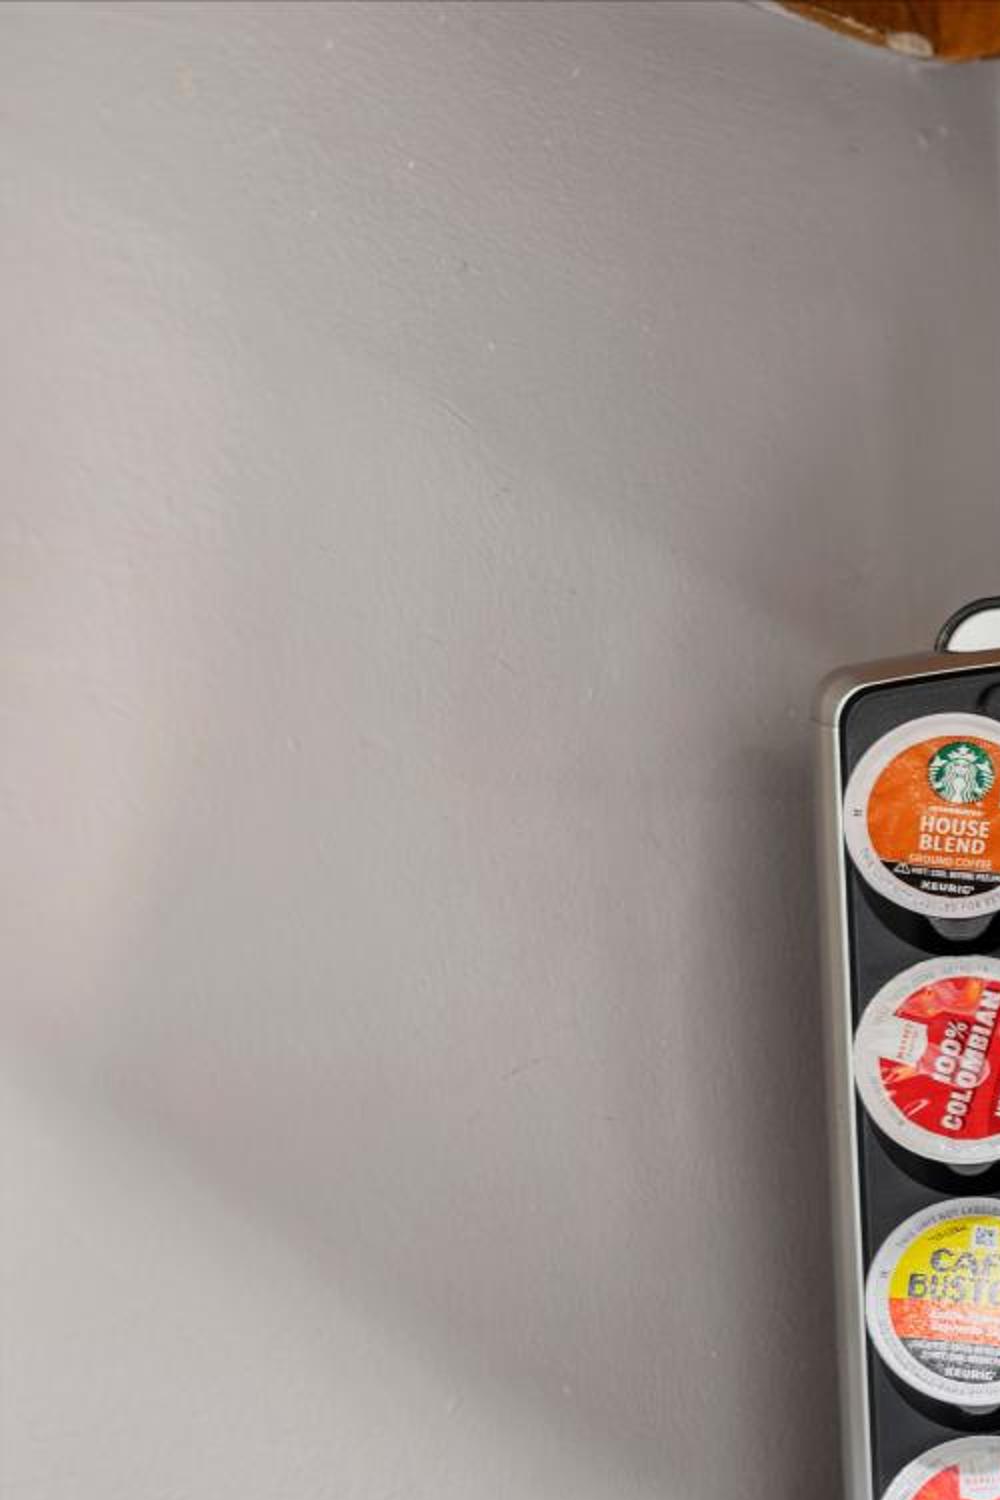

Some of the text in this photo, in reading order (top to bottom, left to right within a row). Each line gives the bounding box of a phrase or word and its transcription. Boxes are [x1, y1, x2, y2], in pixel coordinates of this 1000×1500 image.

[920, 816, 991, 838] HOUSE
[919, 834, 987, 855] BLEND
[920, 881, 971, 895] KEURIG
[929, 1020, 970, 1086] 100%
